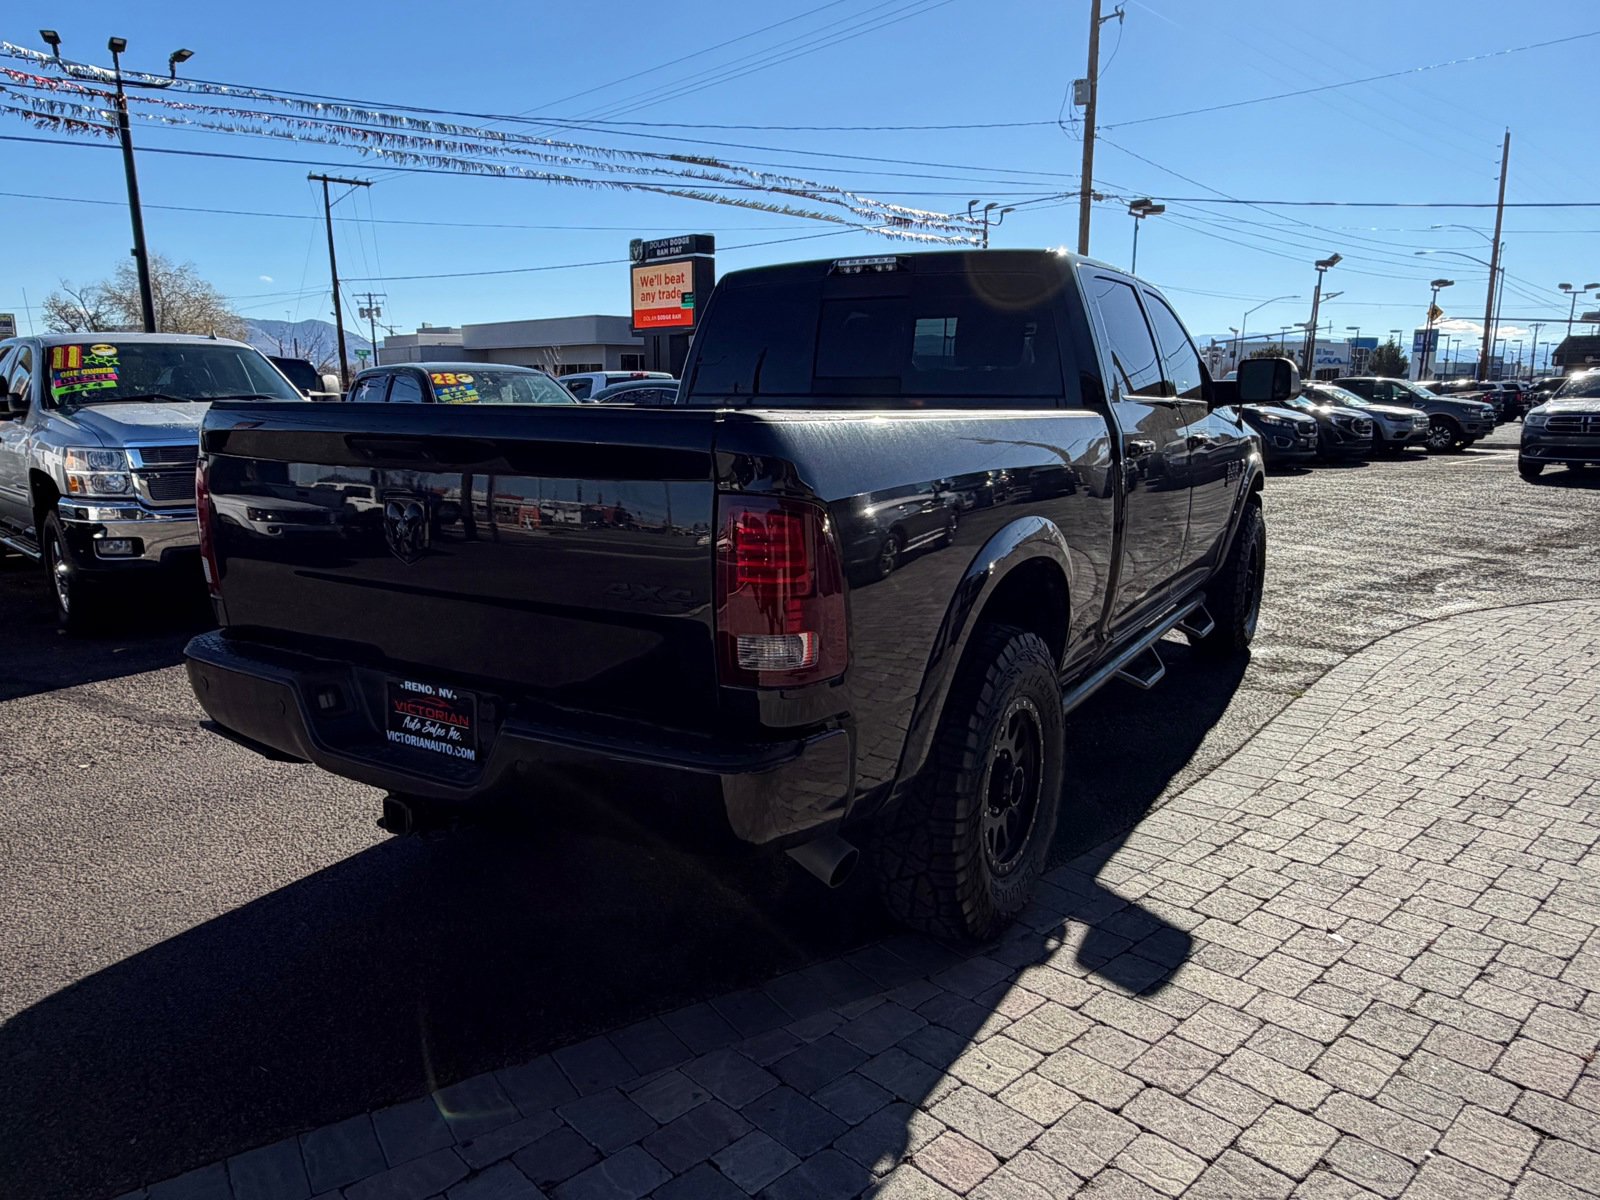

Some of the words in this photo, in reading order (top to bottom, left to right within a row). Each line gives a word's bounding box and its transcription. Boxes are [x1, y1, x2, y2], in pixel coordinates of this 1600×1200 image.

[649, 240, 669, 249] DOLAN
[669, 237, 690, 246] DODGE
[656, 248, 669, 256] RAM
[670, 246, 682, 254] FIAT
[640, 275, 662, 287] We'll
[664, 272, 685, 285] beat
[640, 292, 656, 303] any
[658, 287, 682, 300] trade
[394, 700, 469, 726] VICTORIAN
[402, 716, 421, 731] Auto
[422, 721, 446, 737] Sales
[447, 726, 462, 741] Inc.
[386, 729, 476, 761] VICTORIANAUTO.COM
